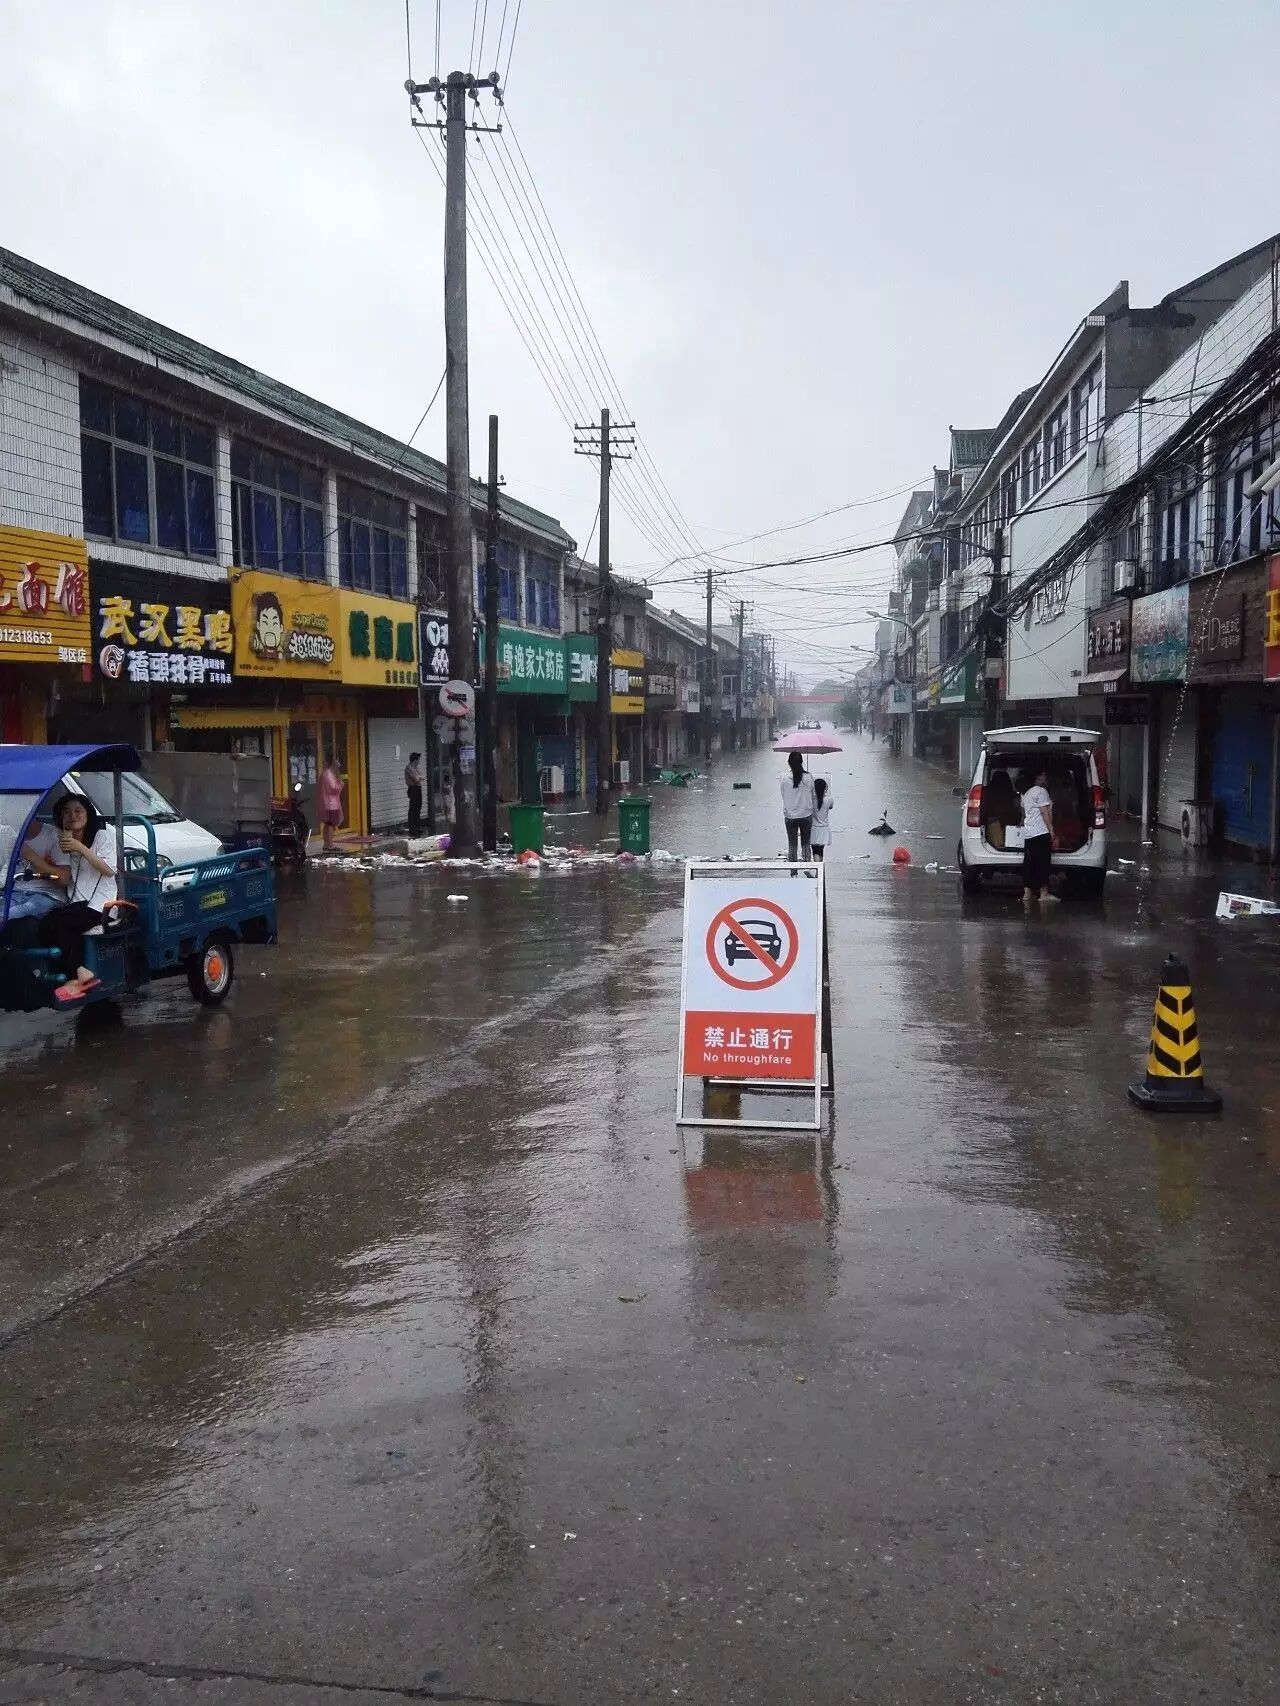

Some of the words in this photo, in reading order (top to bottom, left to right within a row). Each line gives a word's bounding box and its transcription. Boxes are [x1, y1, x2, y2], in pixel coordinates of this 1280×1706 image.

[99, 595, 233, 654] 武汉黑鸭
[58, 646, 87, 663] 邹区店
[704, 1027, 792, 1049] 禁止通行
[703, 1052, 719, 1063] No
[724, 1053, 792, 1065] throughfare
